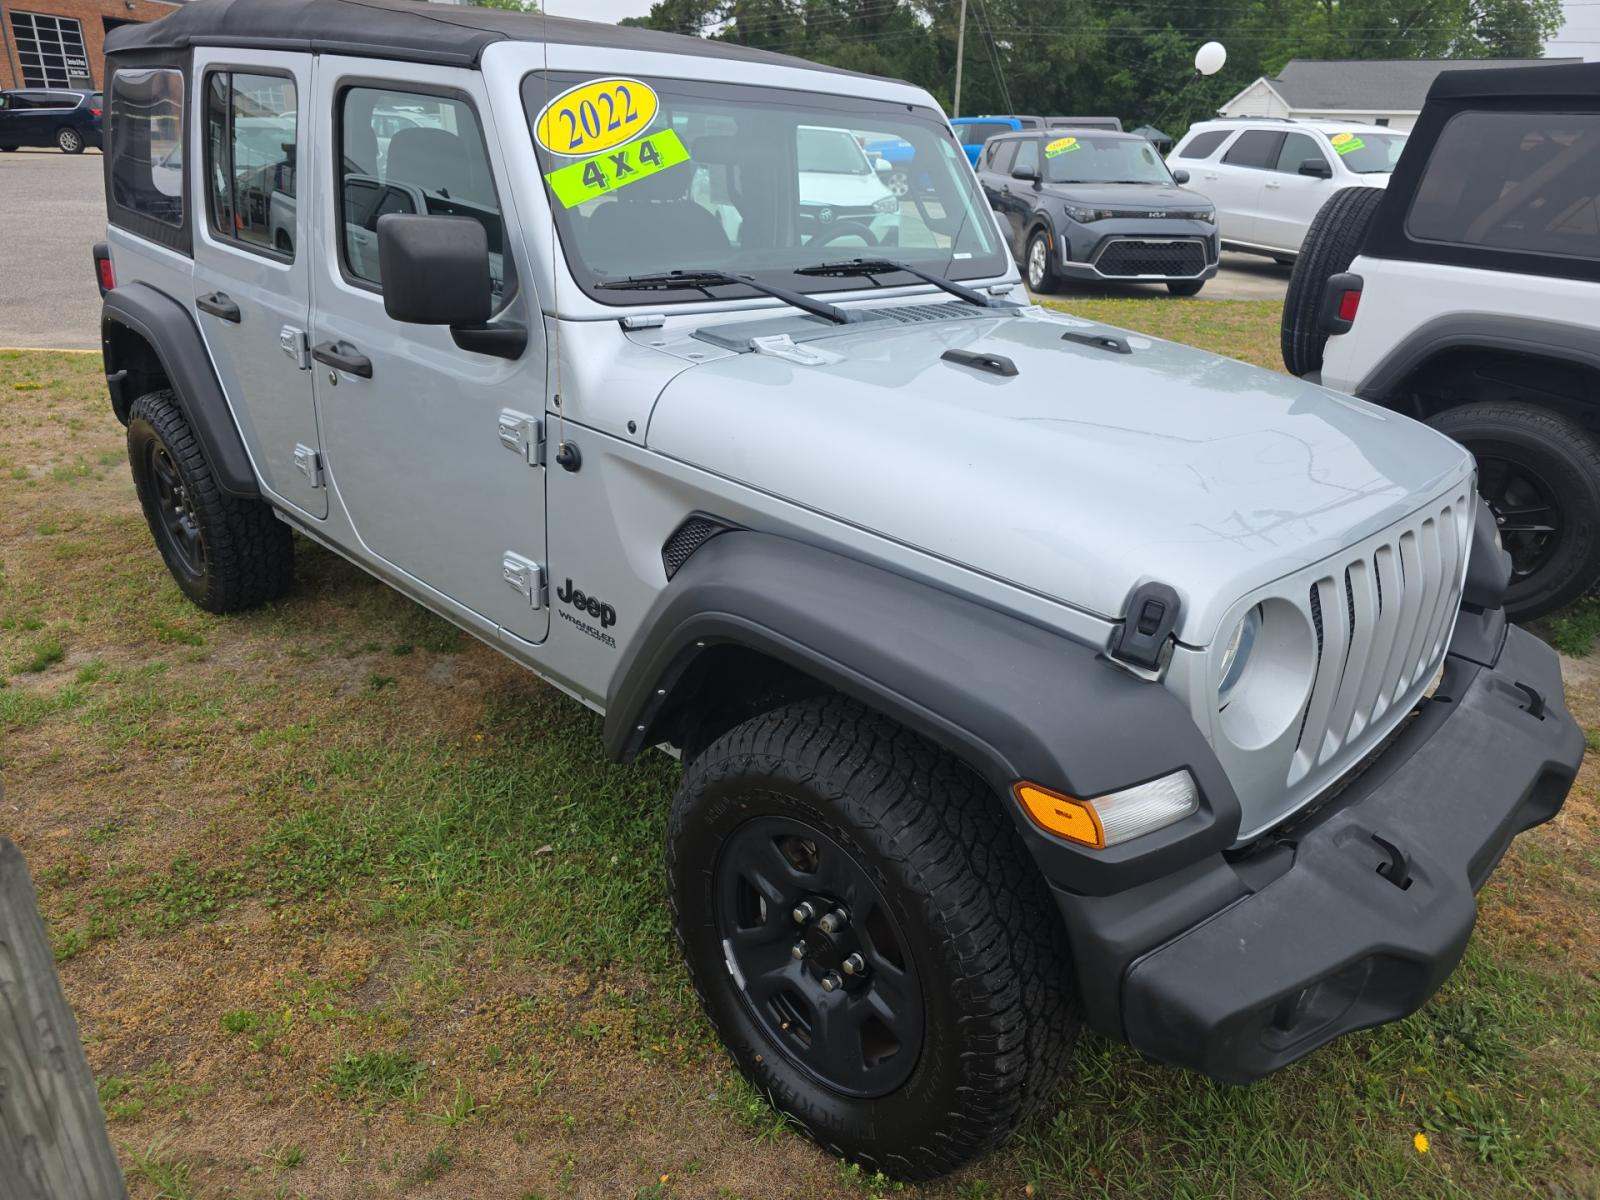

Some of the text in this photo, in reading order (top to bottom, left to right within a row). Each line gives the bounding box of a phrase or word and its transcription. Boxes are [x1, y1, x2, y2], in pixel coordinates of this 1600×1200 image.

[559, 85, 638, 150] 2022
[557, 577, 616, 629] Jeep
[558, 609, 616, 645] WRANGLER
